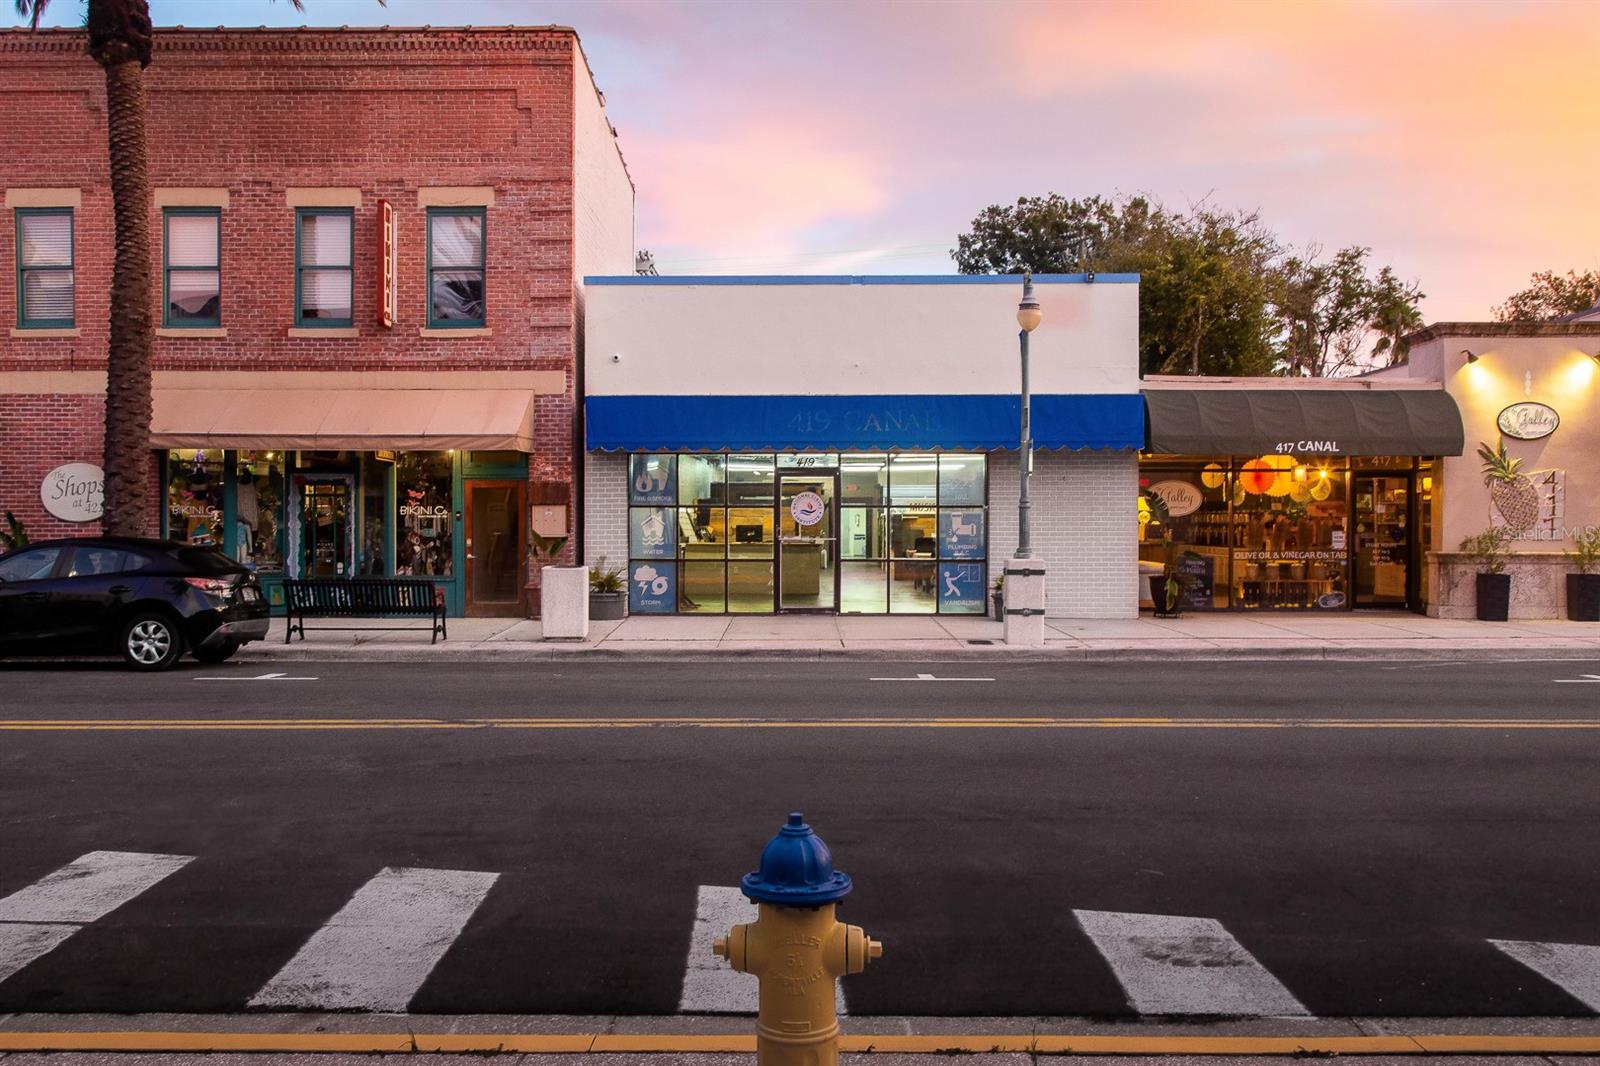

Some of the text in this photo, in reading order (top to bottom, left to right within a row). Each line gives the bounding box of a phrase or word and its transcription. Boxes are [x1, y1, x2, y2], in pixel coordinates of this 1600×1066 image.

[788, 408, 942, 432] 419 CANAL
[1275, 440, 1340, 453] 417 CANAL
[796, 456, 815, 467] 419
[1371, 455, 1391, 467] 417
[51, 475, 104, 503] Shops
[72, 499, 83, 508] at
[400, 505, 432, 515] BIKINI
[1233, 551, 1257, 559] OLIVE
[1258, 551, 1271, 559] OIL
[1272, 551, 1280, 559] &
[1280, 551, 1315, 559] VINEGAR
[1316, 551, 1329, 559] ON
